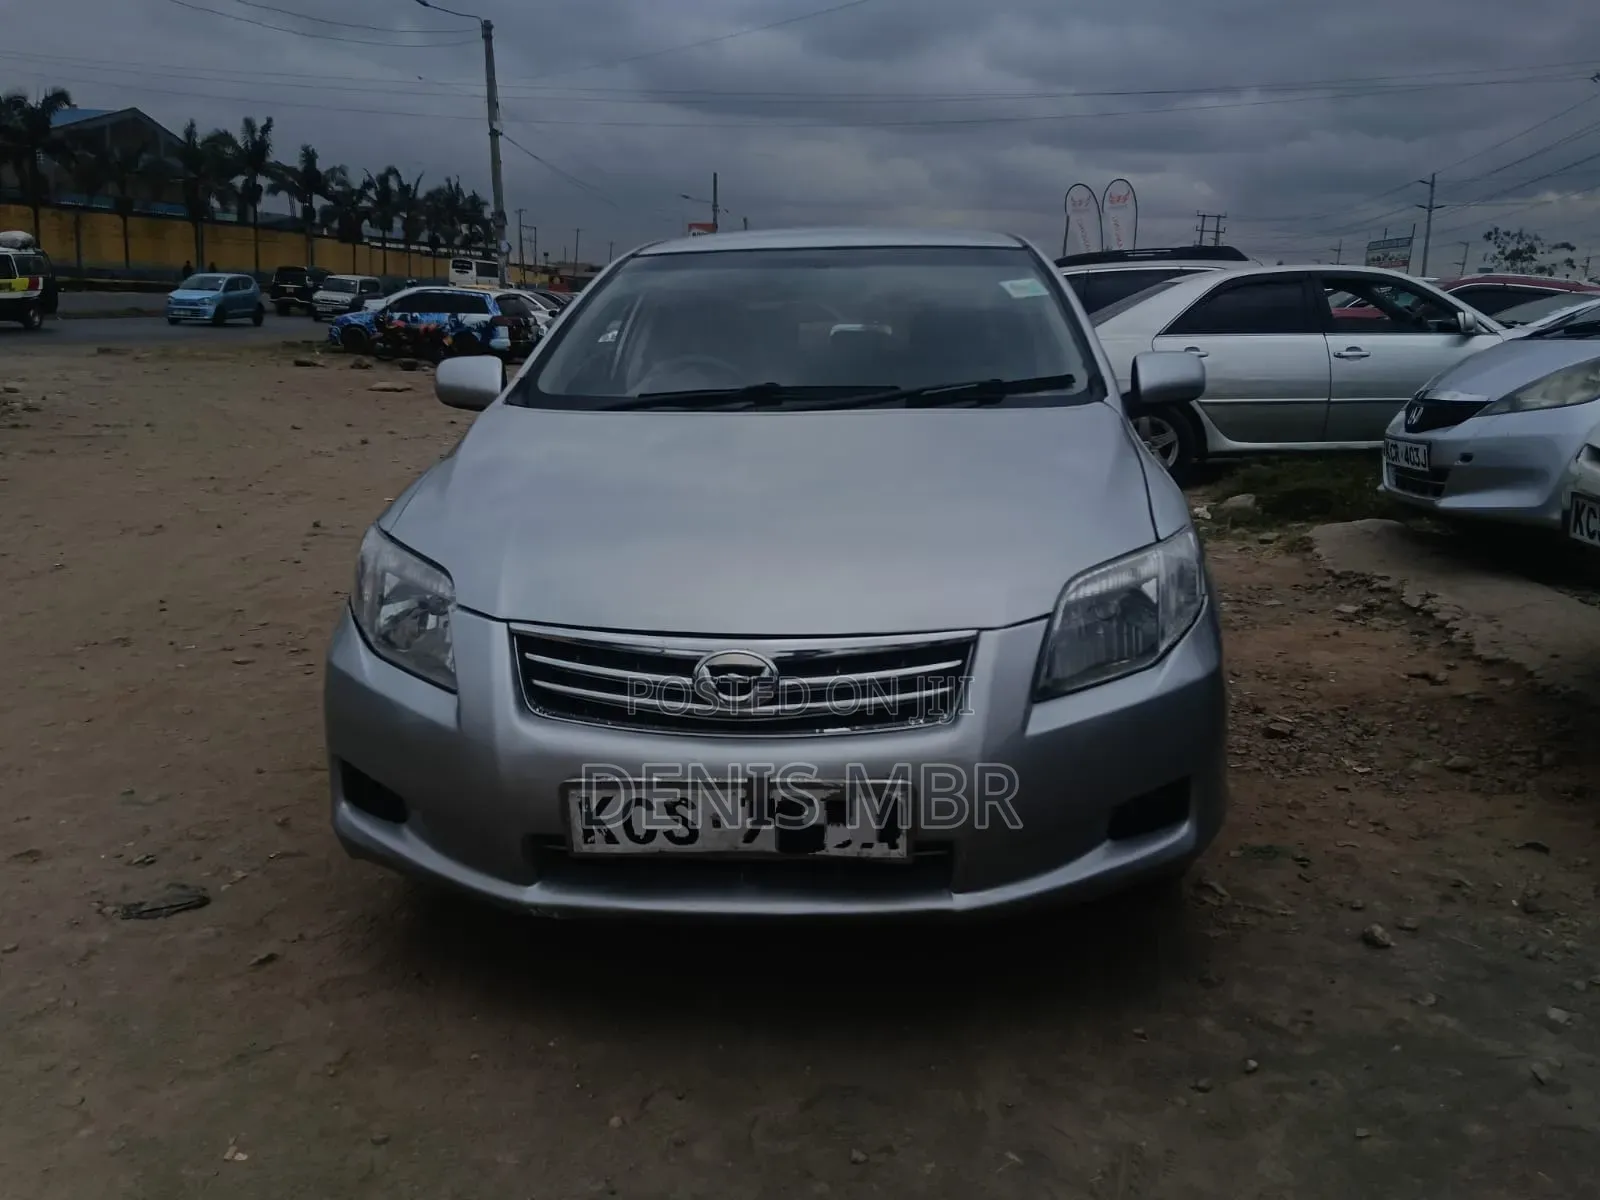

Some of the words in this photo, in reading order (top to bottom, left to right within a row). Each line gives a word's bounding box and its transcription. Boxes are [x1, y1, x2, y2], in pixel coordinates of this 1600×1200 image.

[1404, 443, 1427, 468] 403J
[1573, 499, 1600, 542] KC
[579, 794, 699, 846] KCS
